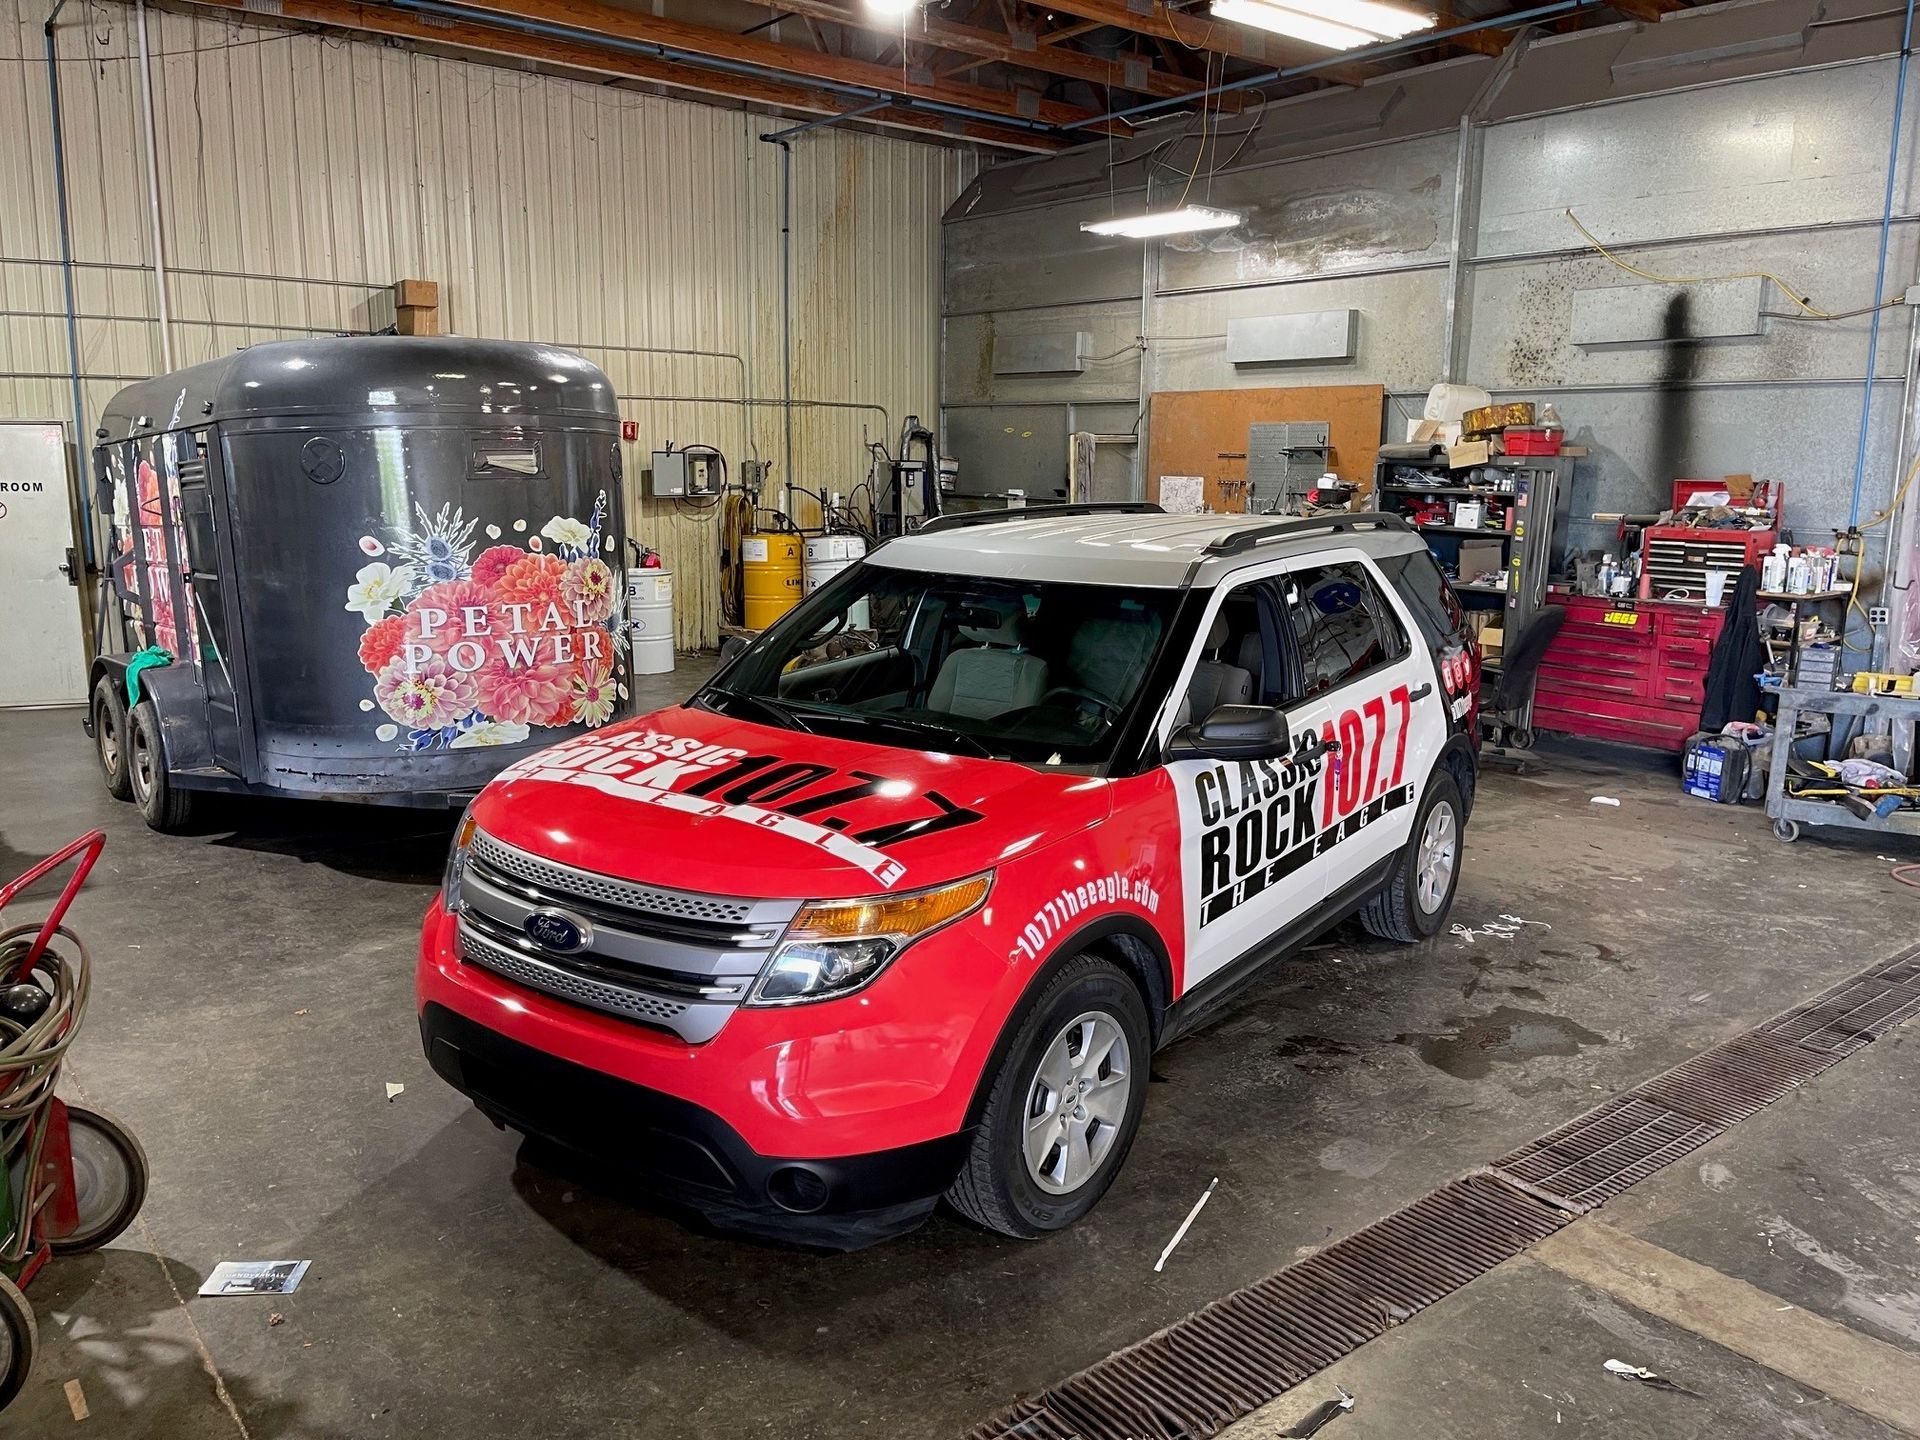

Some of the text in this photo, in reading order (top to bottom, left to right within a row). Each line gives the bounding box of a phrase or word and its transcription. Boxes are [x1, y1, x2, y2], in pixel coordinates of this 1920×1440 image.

[0, 483, 43, 492] ROOM
[787, 547, 794, 556] A
[808, 548, 814, 556] B
[416, 600, 594, 639] PETAL
[1604, 612, 1639, 625] JEGS
[401, 632, 604, 674] POWER
[510, 744, 987, 849] ROCK 107.7
[1195, 728, 1323, 827] CLASSIC
[1201, 684, 1411, 900] ROCK 107.7
[649, 793, 905, 887] EAGLE
[1201, 782, 1415, 925] THE EAGLE
[533, 917, 569, 944] Ford
[1016, 871, 1160, 961] 1077theeagle.com
